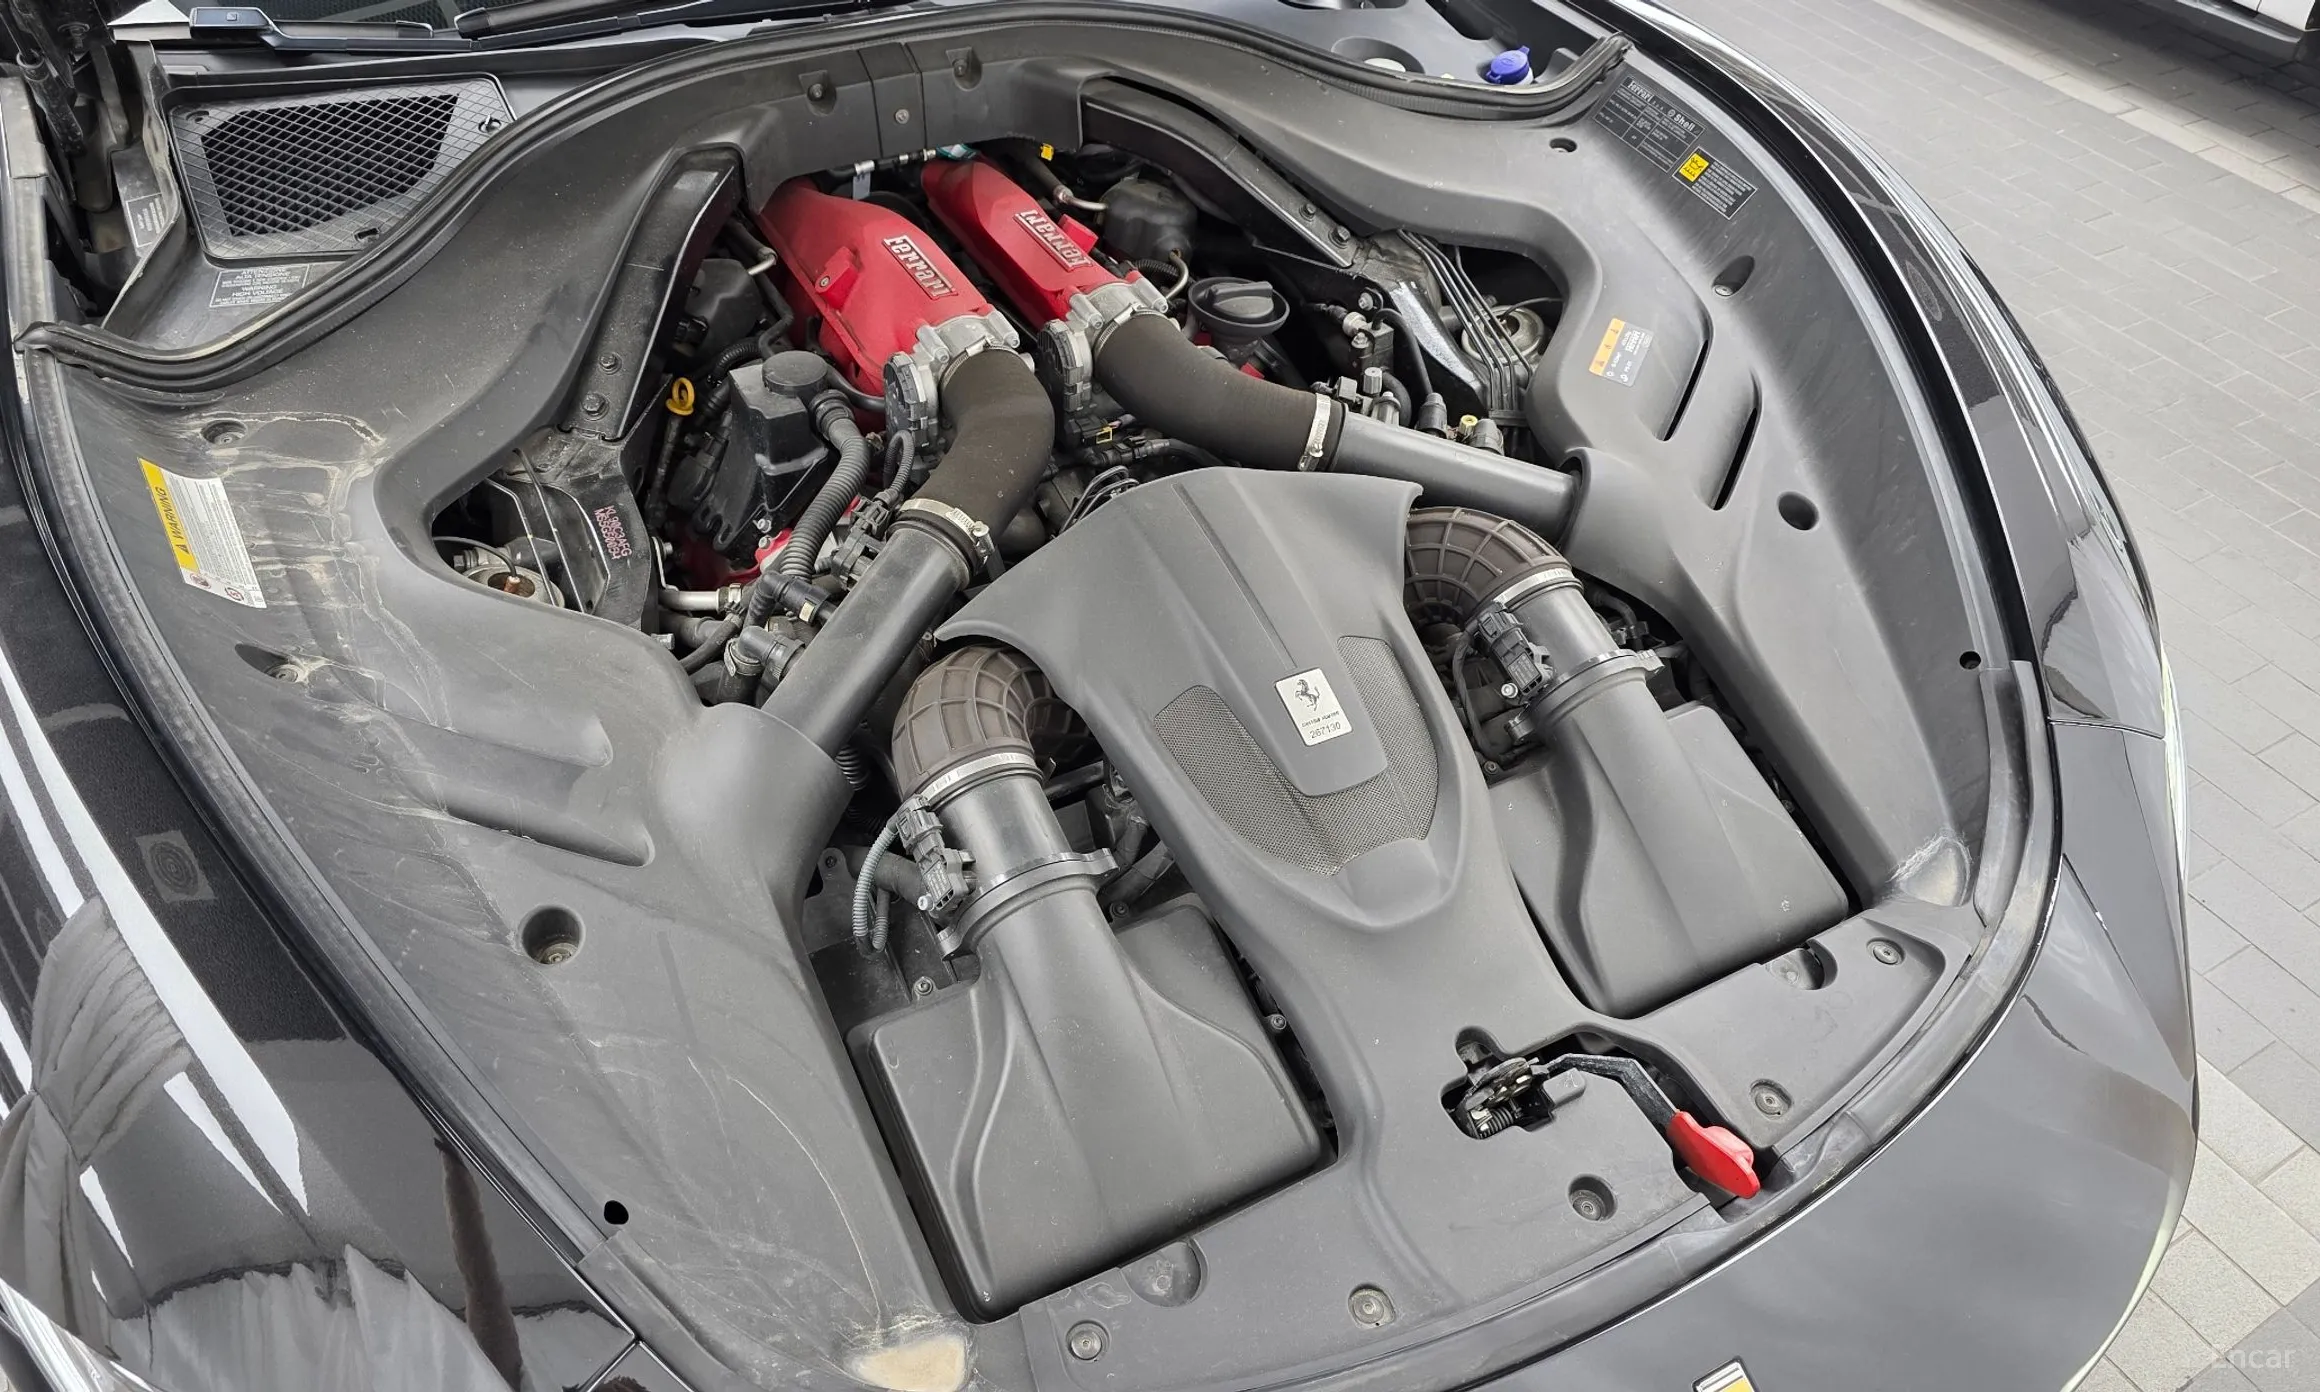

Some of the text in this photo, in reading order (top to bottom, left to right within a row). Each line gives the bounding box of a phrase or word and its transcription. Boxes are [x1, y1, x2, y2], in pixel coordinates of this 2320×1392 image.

[1628, 80, 1655, 102] Ferrari
[1673, 113, 1696, 132] Shell
[1013, 209, 1093, 271] Ferrari
[883, 235, 957, 298] Ferrari
[155, 486, 185, 540] WARNING
[1310, 721, 1341, 739] 267130
